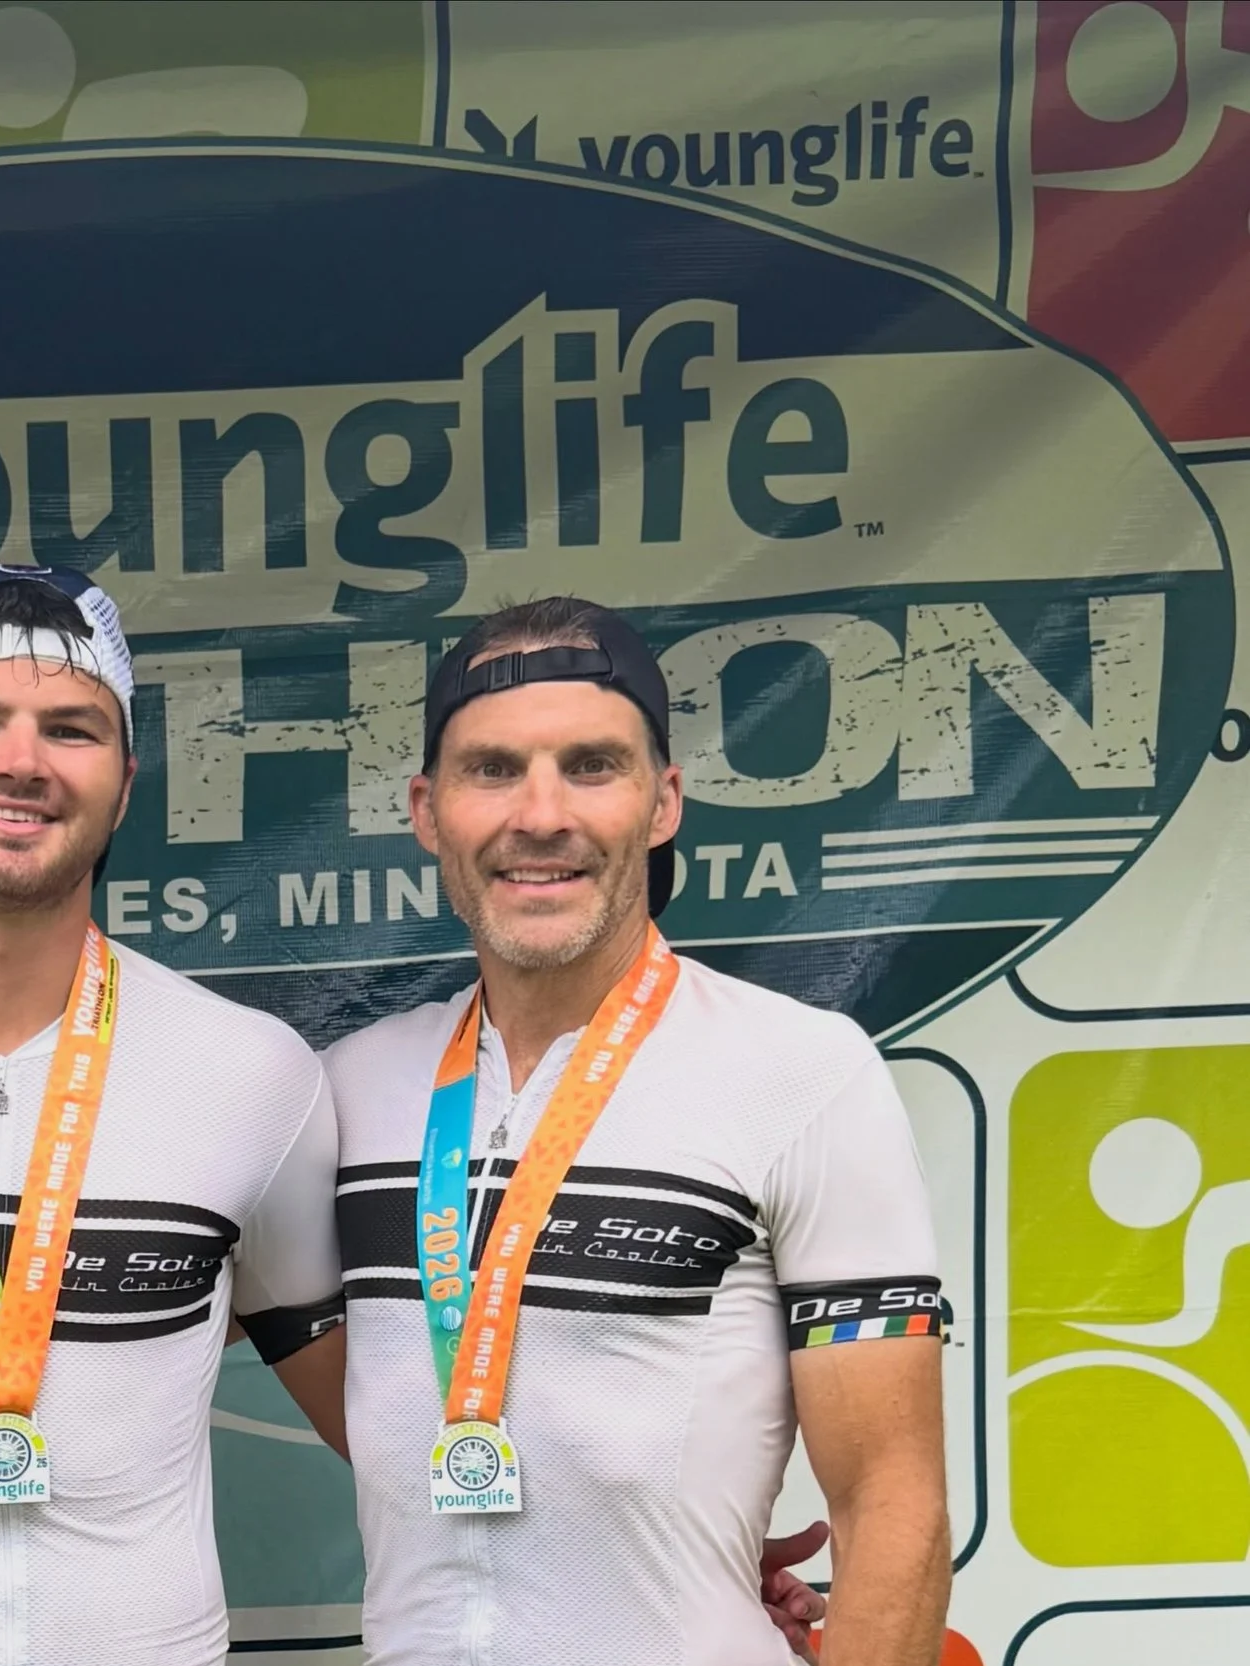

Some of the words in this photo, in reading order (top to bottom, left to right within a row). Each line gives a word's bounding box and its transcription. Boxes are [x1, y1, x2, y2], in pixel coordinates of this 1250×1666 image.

[71, 927, 104, 1036] younglife
[584, 1050, 613, 1084] YOU
[606, 1004, 641, 1046] WERE
[69, 1053, 91, 1092] THIS
[59, 1101, 81, 1134] FOR
[34, 1197, 59, 1248] WERE
[500, 1223, 523, 1257] YOU
[594, 1218, 721, 1252] Soto
[423, 1207, 464, 1301] 2026
[533, 1239, 574, 1256] in
[584, 1242, 702, 1268] Cooler
[25, 1256, 47, 1292] YOU
[61, 1277, 107, 1292] in
[483, 1267, 508, 1319] WERE
[790, 1298, 861, 1325] De
[878, 1287, 941, 1311] So
[471, 1328, 496, 1379] MADE
[434, 1489, 515, 1511] younglife
